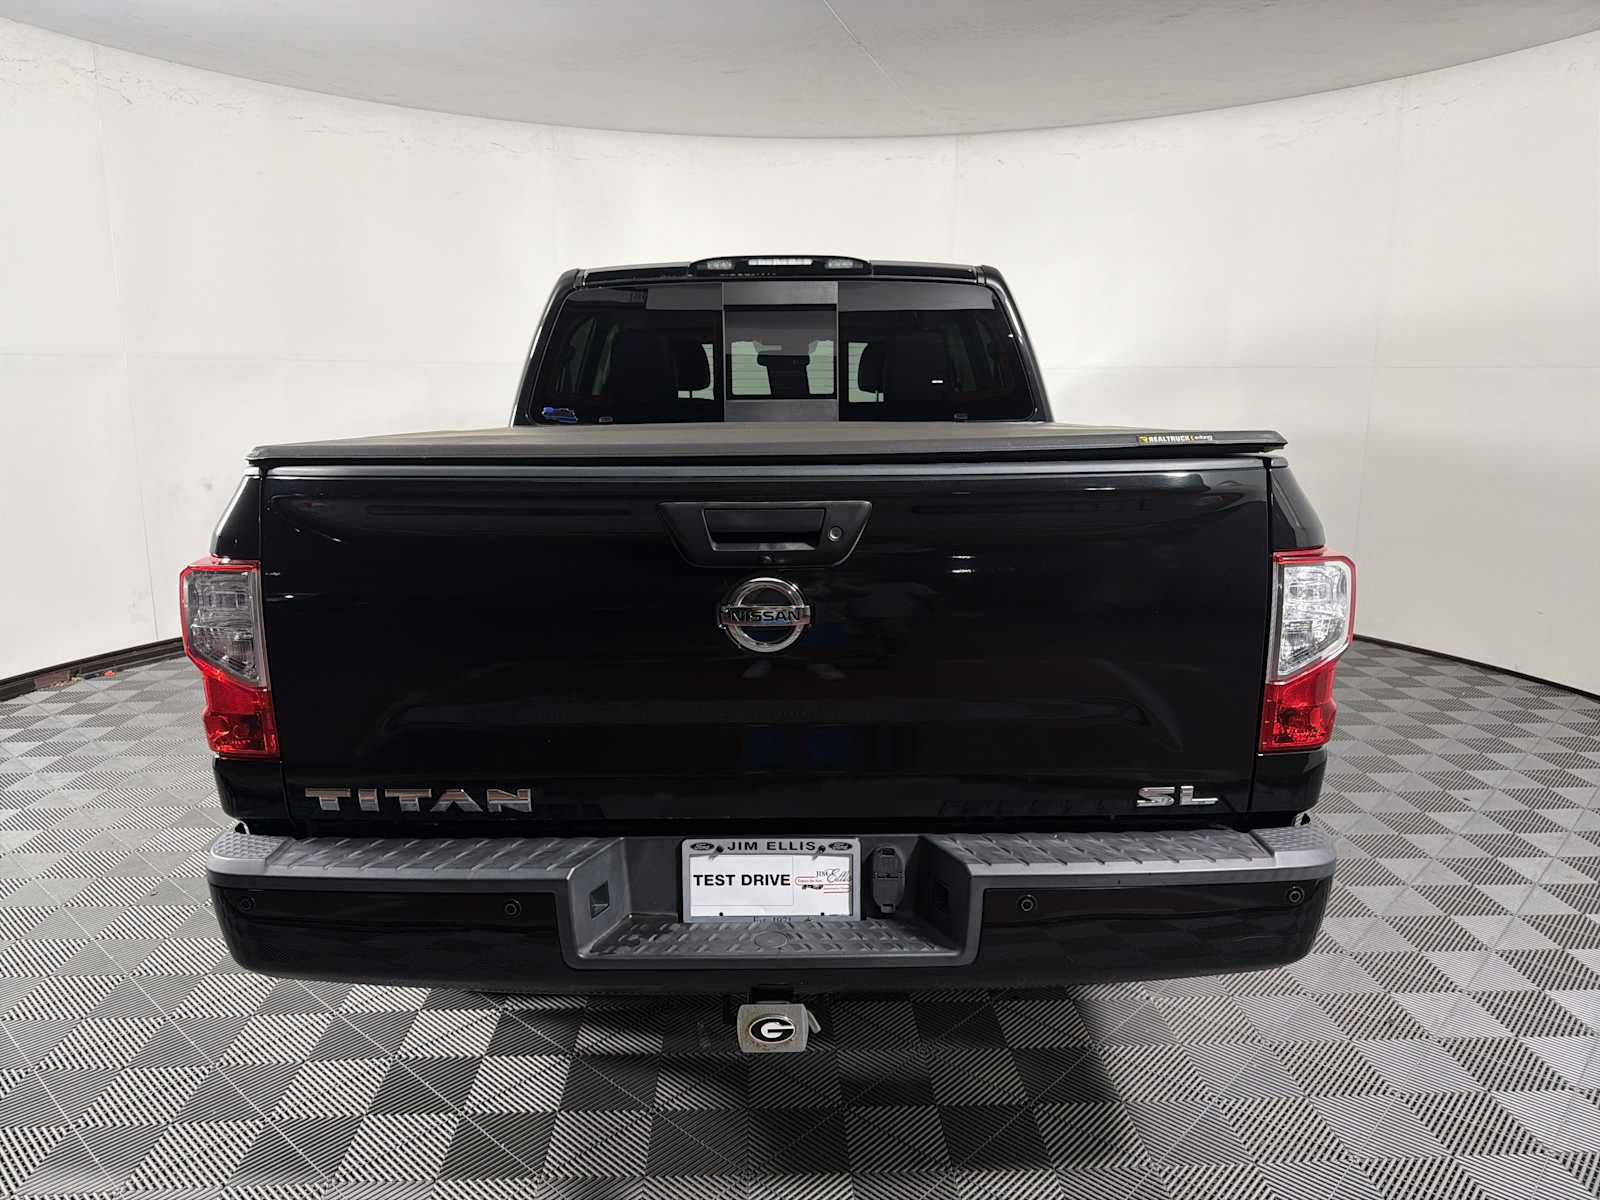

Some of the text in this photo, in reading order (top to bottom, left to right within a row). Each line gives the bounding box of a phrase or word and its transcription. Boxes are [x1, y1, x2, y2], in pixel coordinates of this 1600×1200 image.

[731, 610, 800, 622] NISSAN
[305, 788, 532, 812] TITAN
[1136, 785, 1218, 807] SL
[727, 841, 816, 851] JIM ELLIS
[693, 874, 791, 886] TEST DRIVE
[761, 1022, 794, 1039] G
